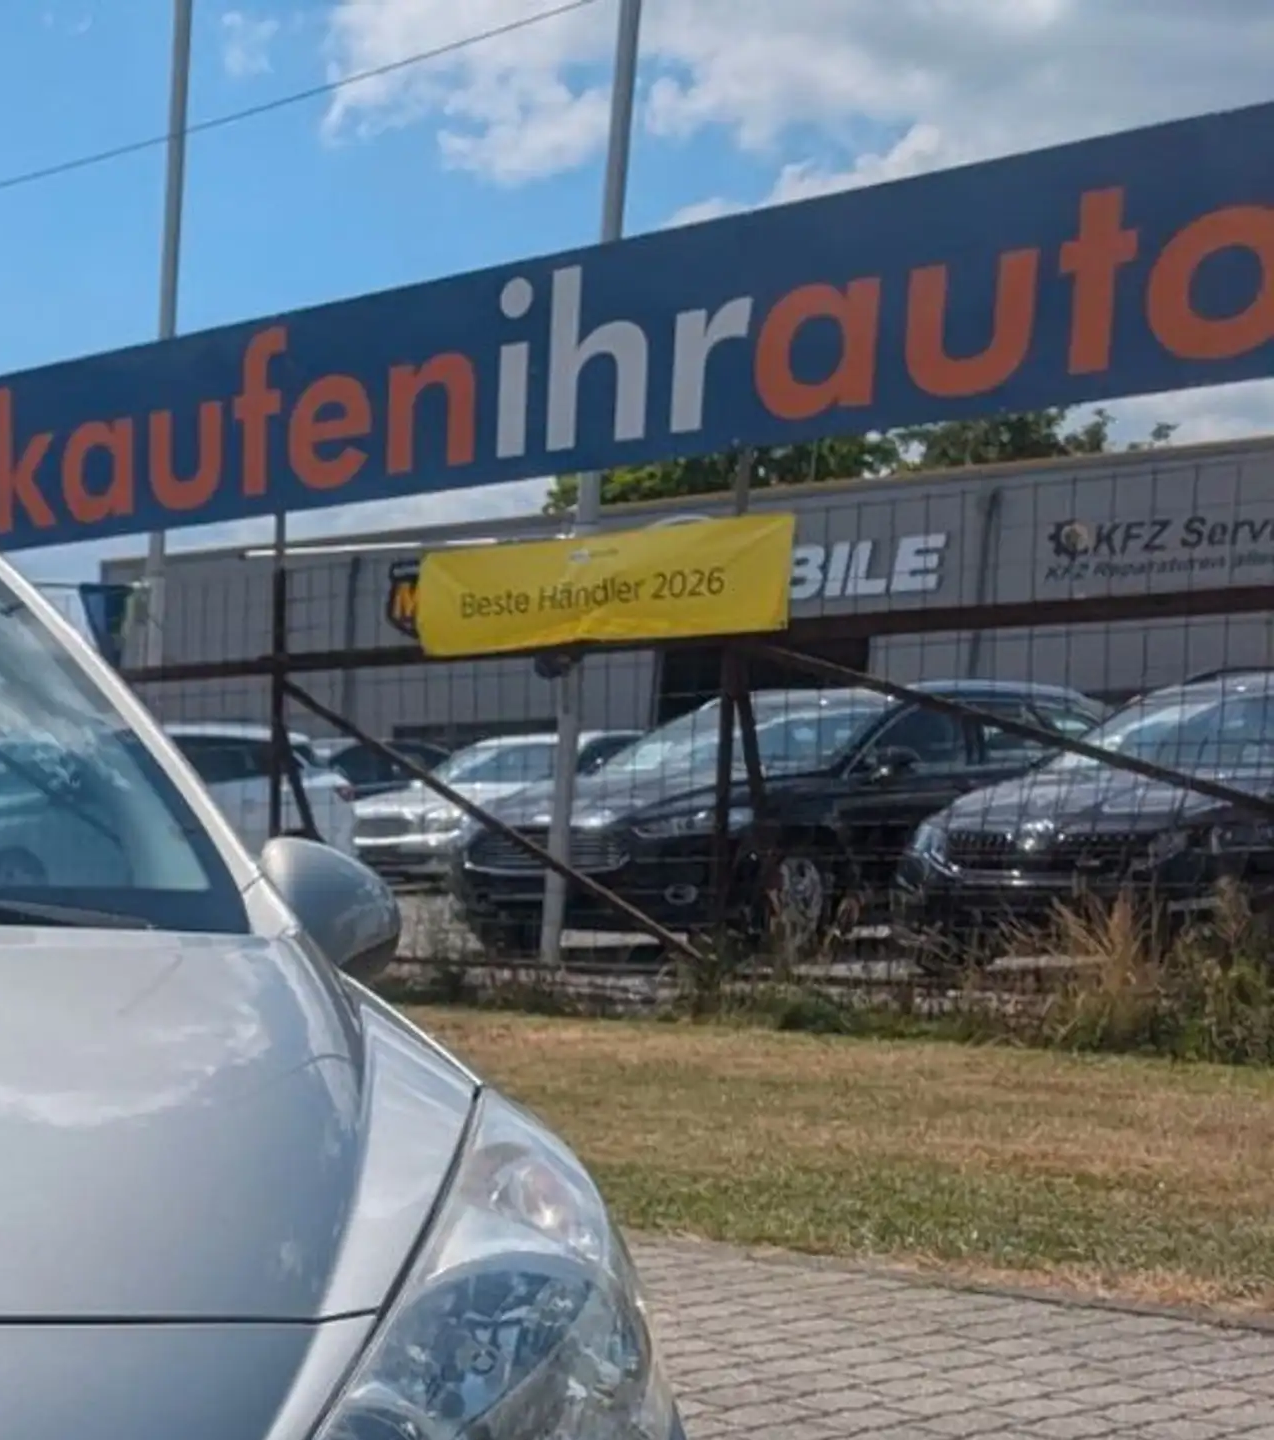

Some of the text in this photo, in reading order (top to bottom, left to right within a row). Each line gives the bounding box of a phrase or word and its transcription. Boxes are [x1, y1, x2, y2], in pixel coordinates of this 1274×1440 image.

[1094, 516, 1274, 555] KFZ Serv
[460, 566, 726, 619] Beste Händler 2026
